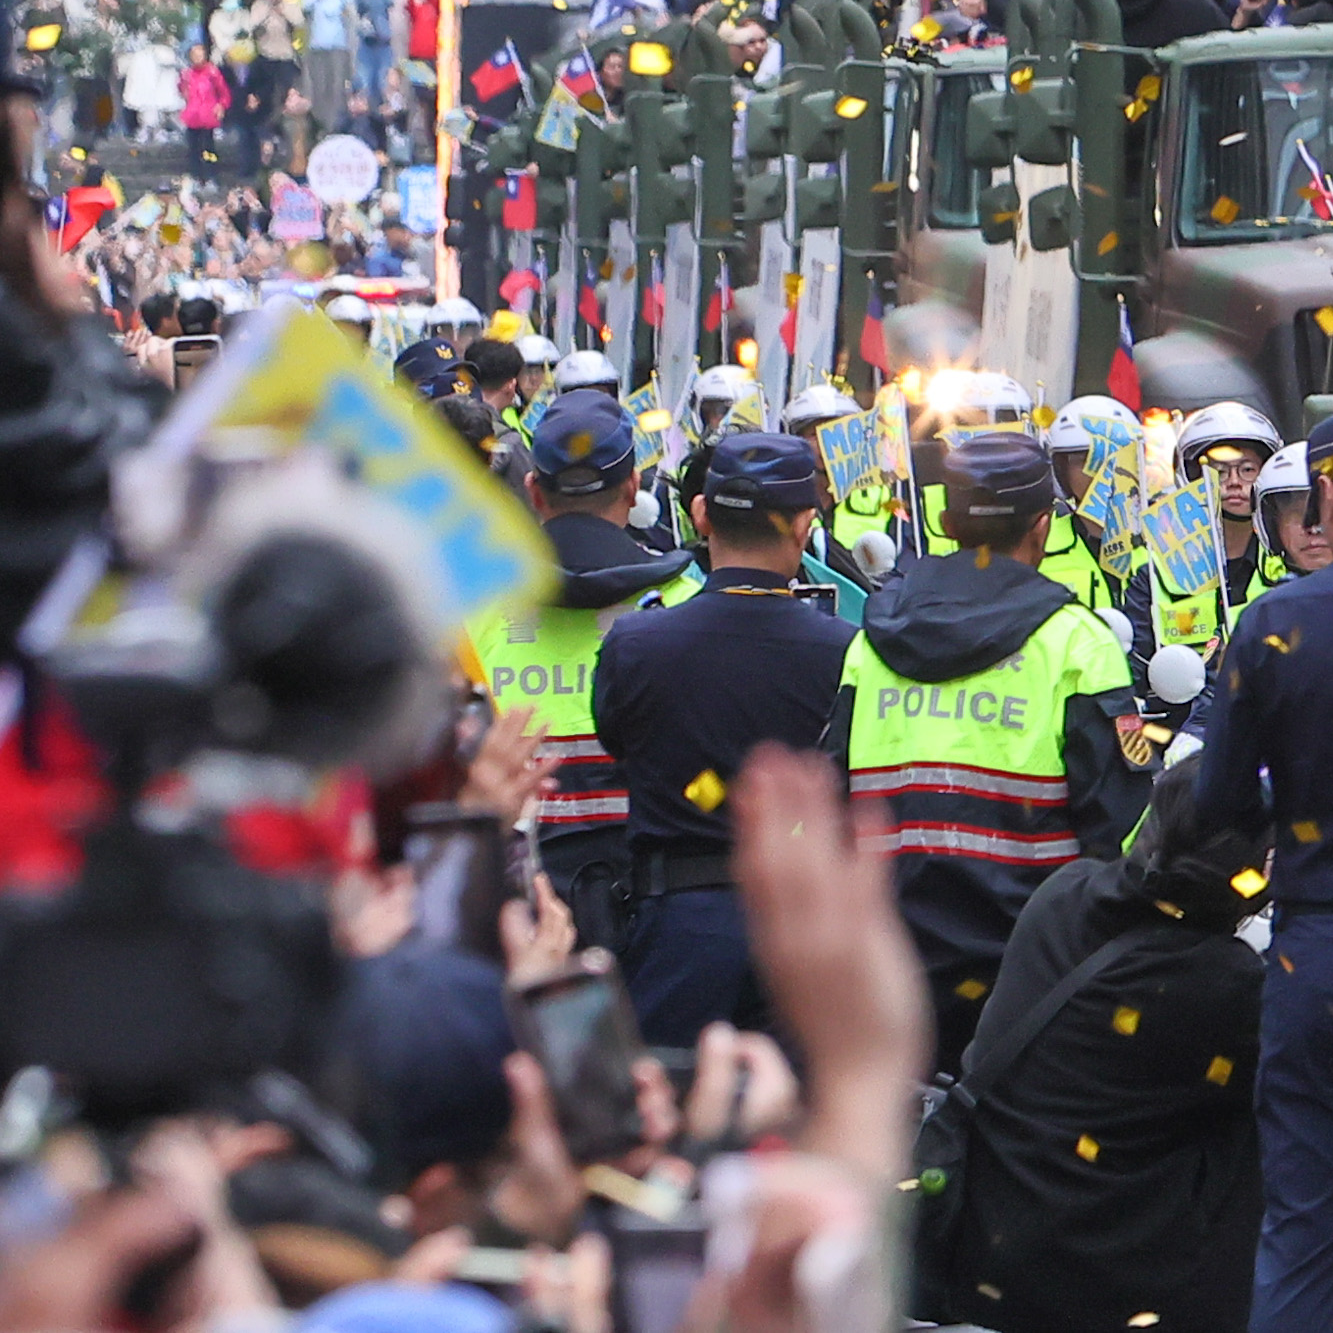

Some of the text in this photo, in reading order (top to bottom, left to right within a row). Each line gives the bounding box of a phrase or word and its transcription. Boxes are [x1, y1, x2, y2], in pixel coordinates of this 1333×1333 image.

[1164, 623, 1208, 638] POCE
[492, 663, 587, 697] POLI
[877, 686, 1029, 730] POLICE
